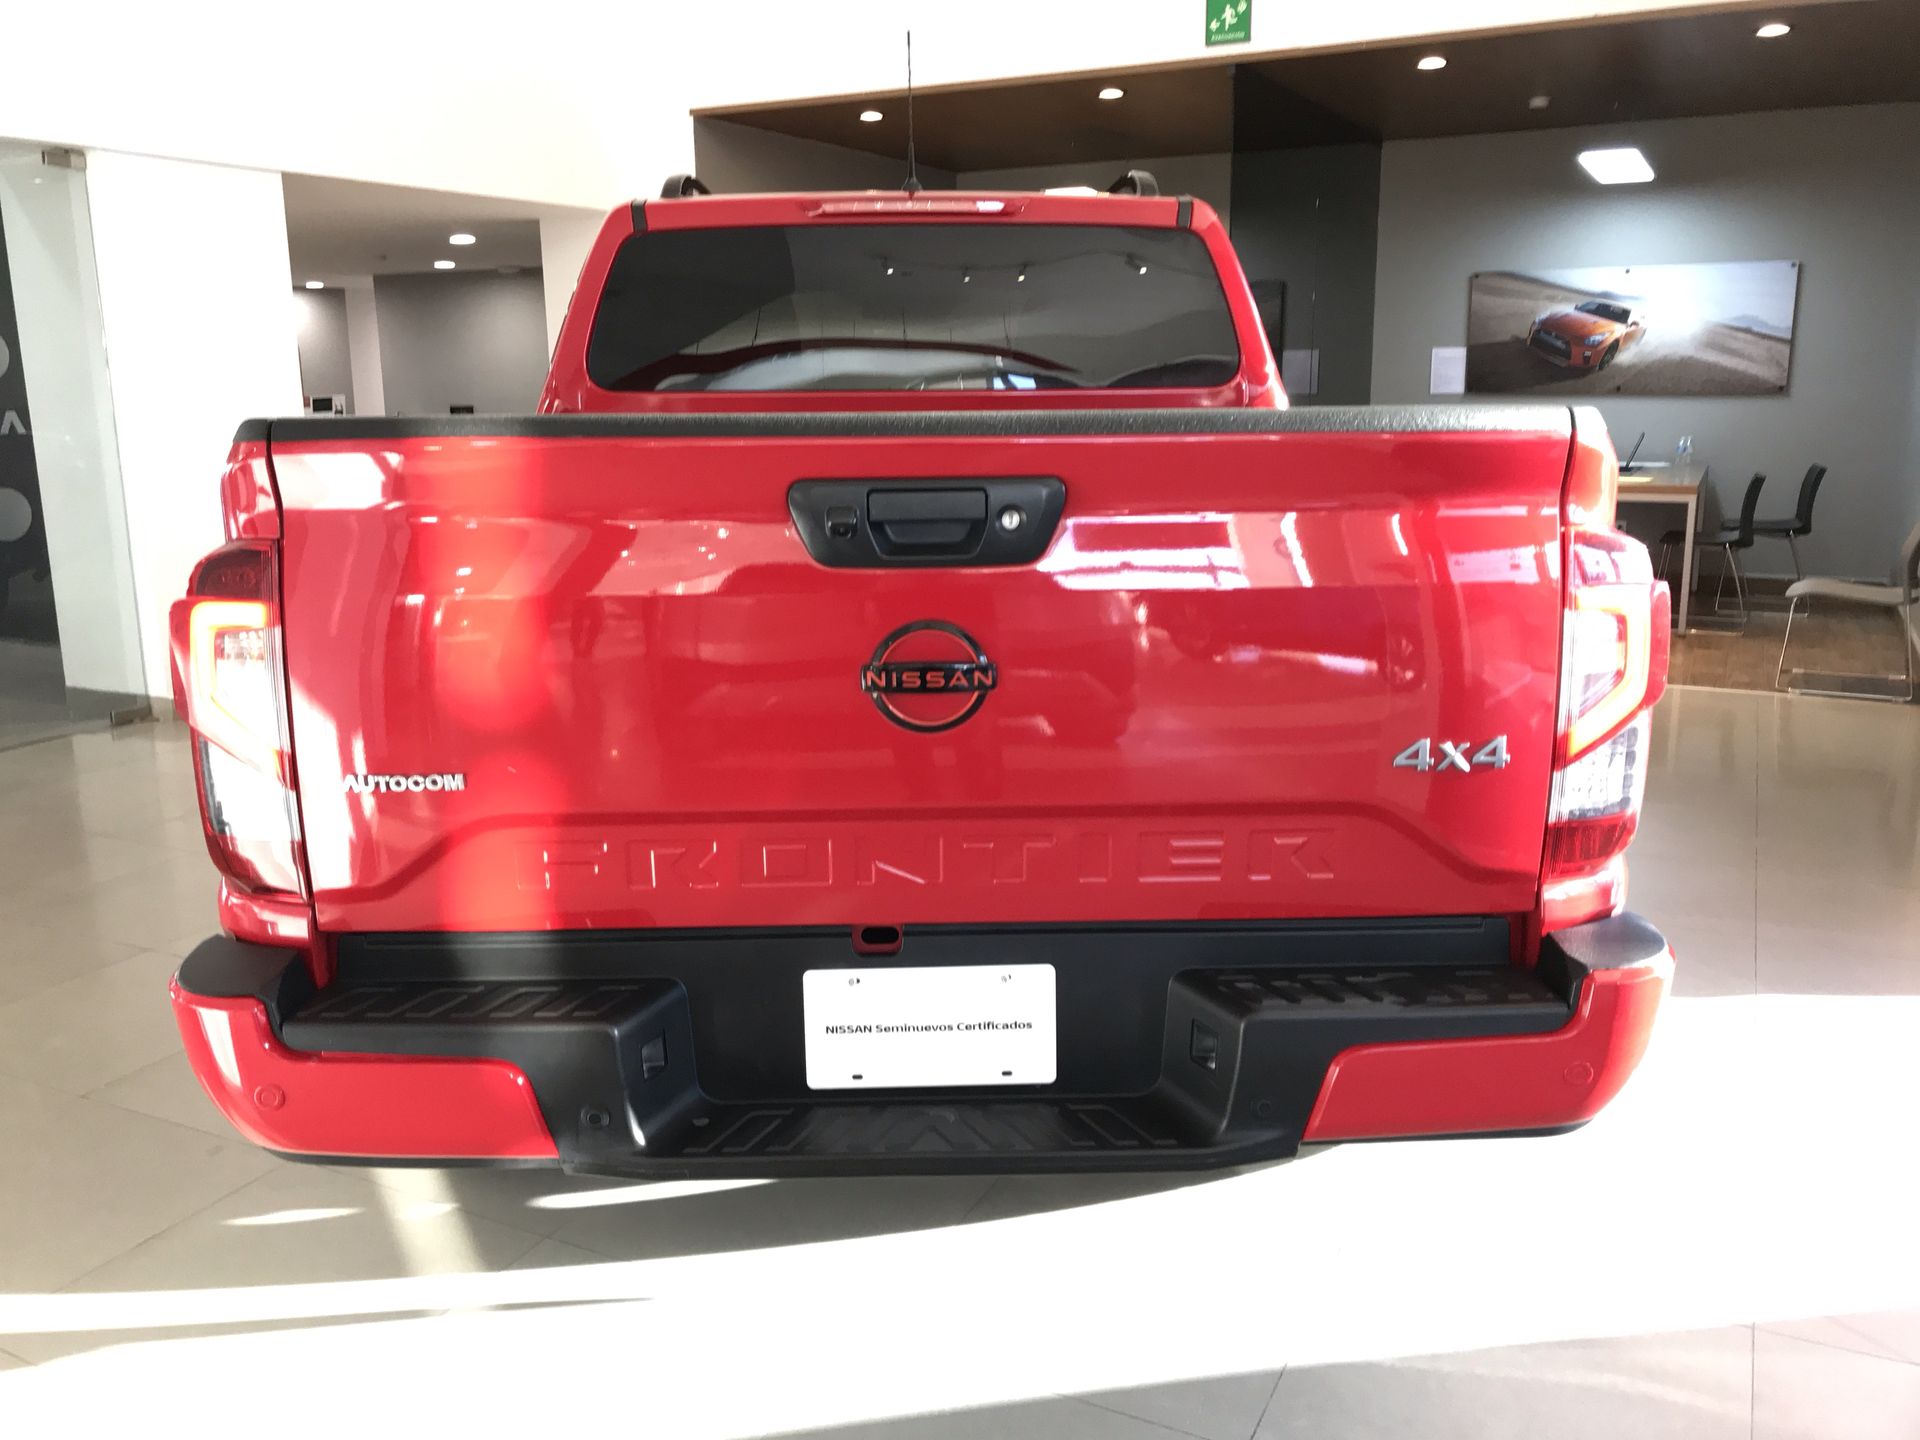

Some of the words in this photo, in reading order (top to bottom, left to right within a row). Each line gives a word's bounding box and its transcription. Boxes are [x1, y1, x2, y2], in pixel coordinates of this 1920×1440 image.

[865, 668, 993, 689] NISSAN
[1393, 733, 1511, 774] 4x4
[343, 773, 466, 794] AUTOCOM
[516, 832, 1337, 890] FRONTIER
[825, 1023, 873, 1035] NISSAN
[875, 1021, 954, 1033] Seminuevos
[956, 1019, 1033, 1032] Certificados
